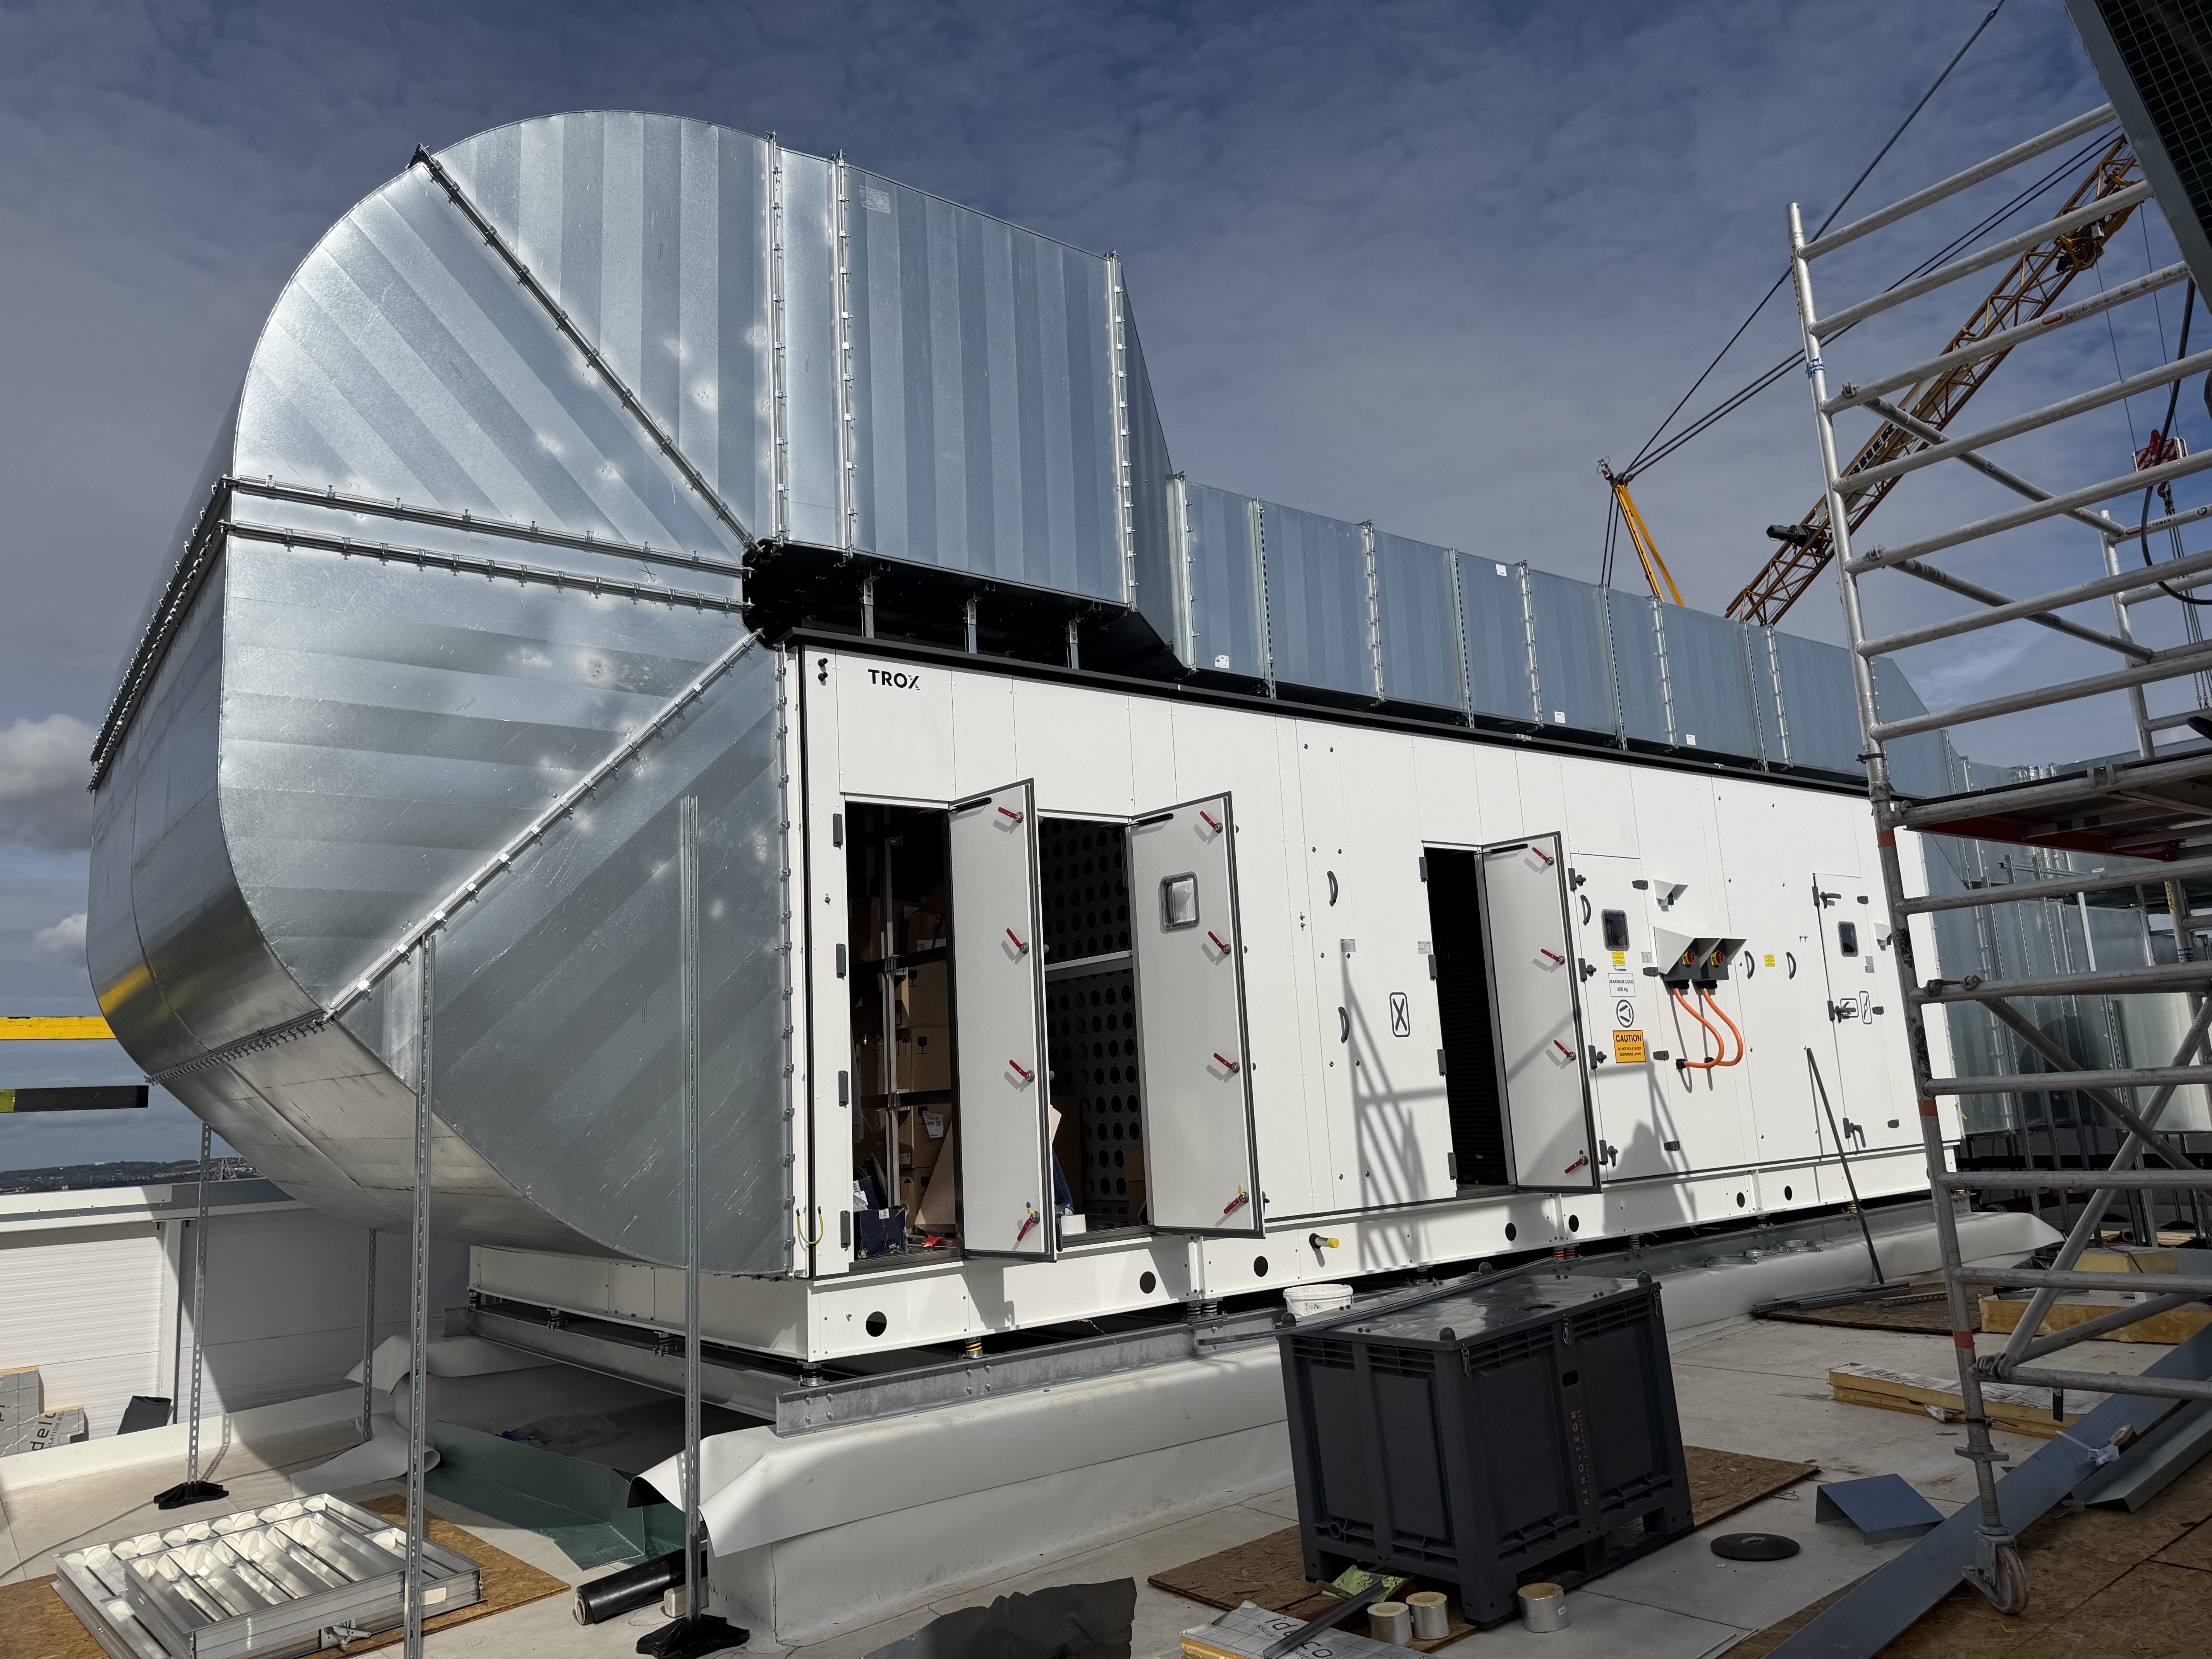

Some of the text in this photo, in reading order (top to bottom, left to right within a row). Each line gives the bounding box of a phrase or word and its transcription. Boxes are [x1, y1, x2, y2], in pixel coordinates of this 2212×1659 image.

[2152, 518, 2171, 527] TOWER
[867, 669, 920, 691] TROX
[1616, 1034, 1642, 1042] CAUTION
[1570, 1411, 1590, 1506] RENO-TECH
